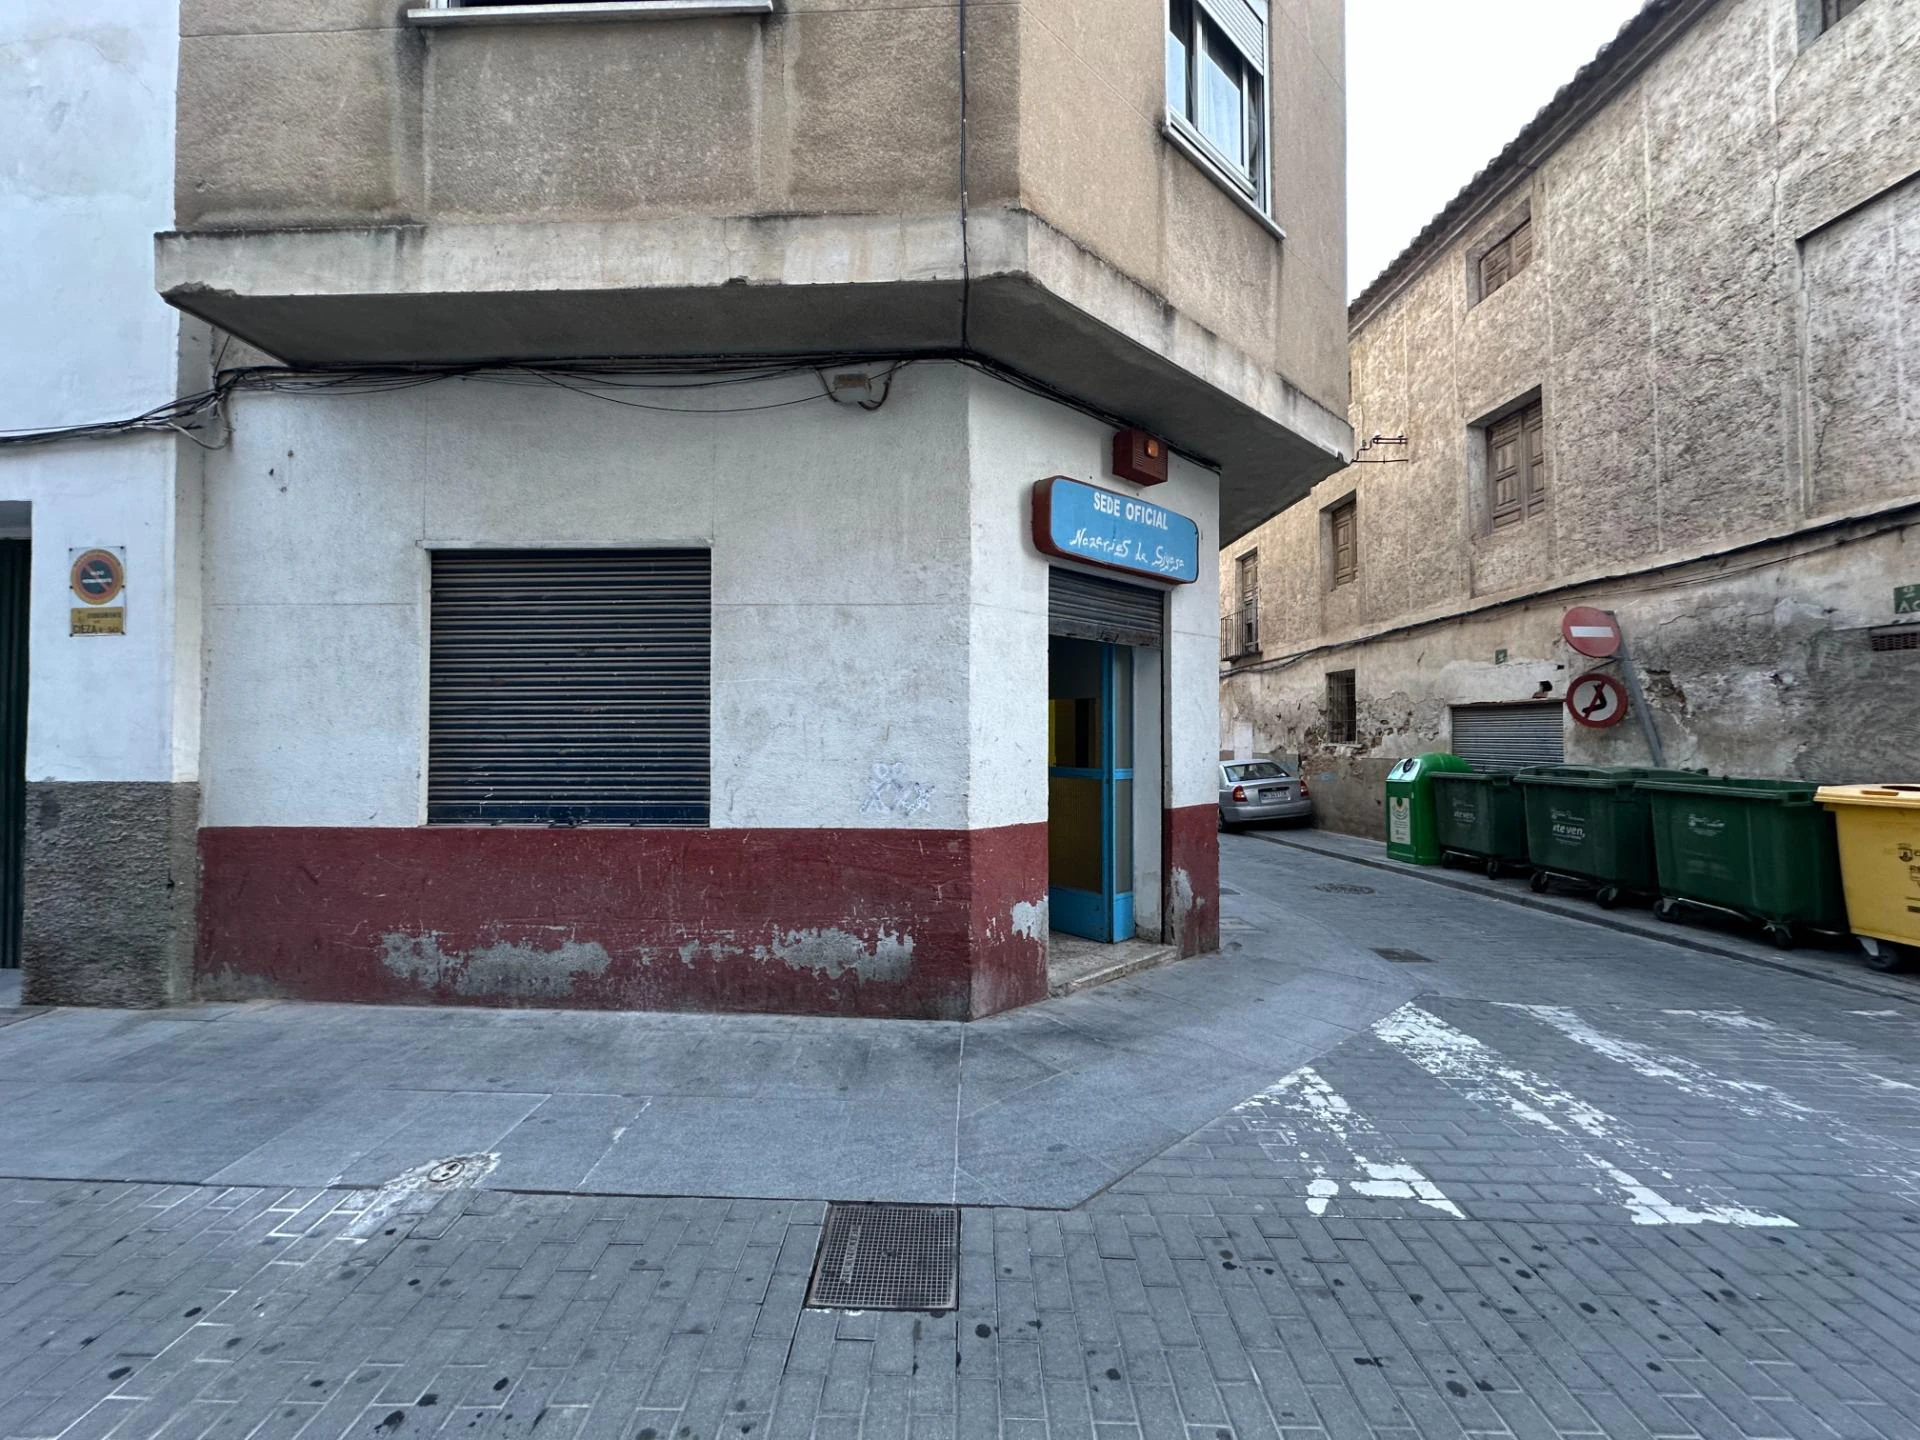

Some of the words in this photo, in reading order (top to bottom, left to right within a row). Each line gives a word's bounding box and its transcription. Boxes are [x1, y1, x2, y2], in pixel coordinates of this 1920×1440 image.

[1093, 491, 1121, 517] SEDE
[1125, 502, 1169, 530] OFICIAL
[1135, 542, 1148, 563] de
